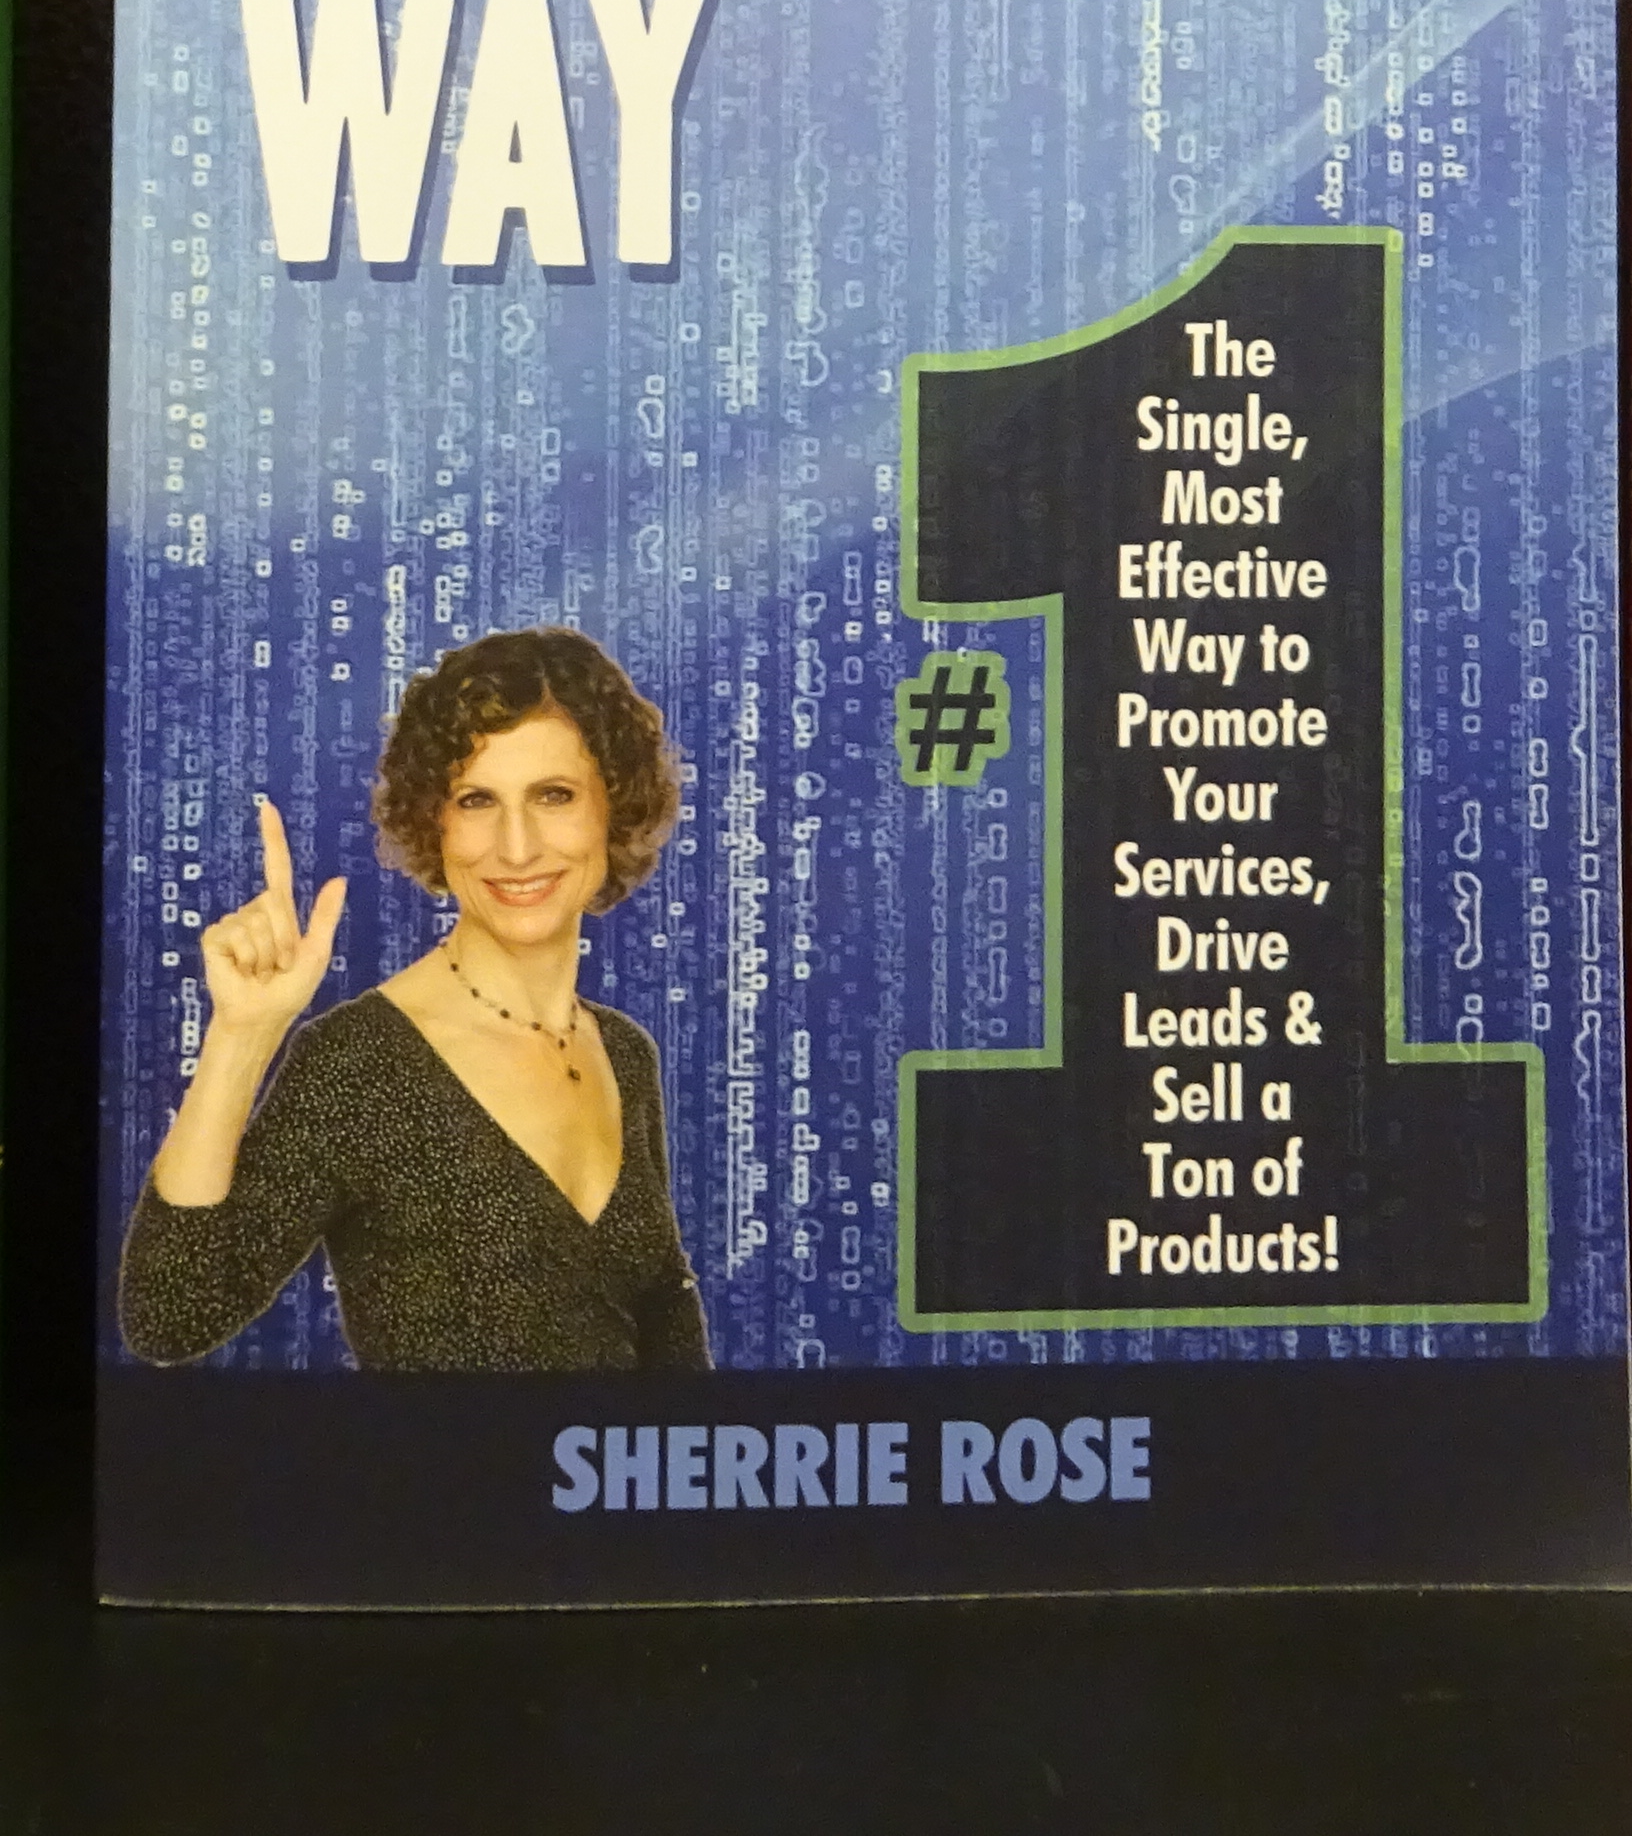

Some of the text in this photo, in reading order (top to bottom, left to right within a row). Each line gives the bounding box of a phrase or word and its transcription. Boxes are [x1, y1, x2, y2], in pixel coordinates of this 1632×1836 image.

[1184, 319, 1276, 378] The
[1137, 393, 1308, 461] Single,
[1161, 470, 1284, 525] Most
[1119, 542, 1328, 599] Effective
[1133, 618, 1310, 687] Way to
[1118, 695, 1328, 748] Promote
[1163, 766, 1279, 822] Your
[1114, 842, 1330, 905] Services,
[1157, 916, 1289, 972] Drive
[1124, 989, 1322, 1048] Leads &
[1152, 1063, 1291, 1123] Sell a
[1142, 1137, 1304, 1199] Ton of
[1107, 1213, 1339, 1275] Products!
[552, 1416, 1151, 1513] SHERRIE ROSE
